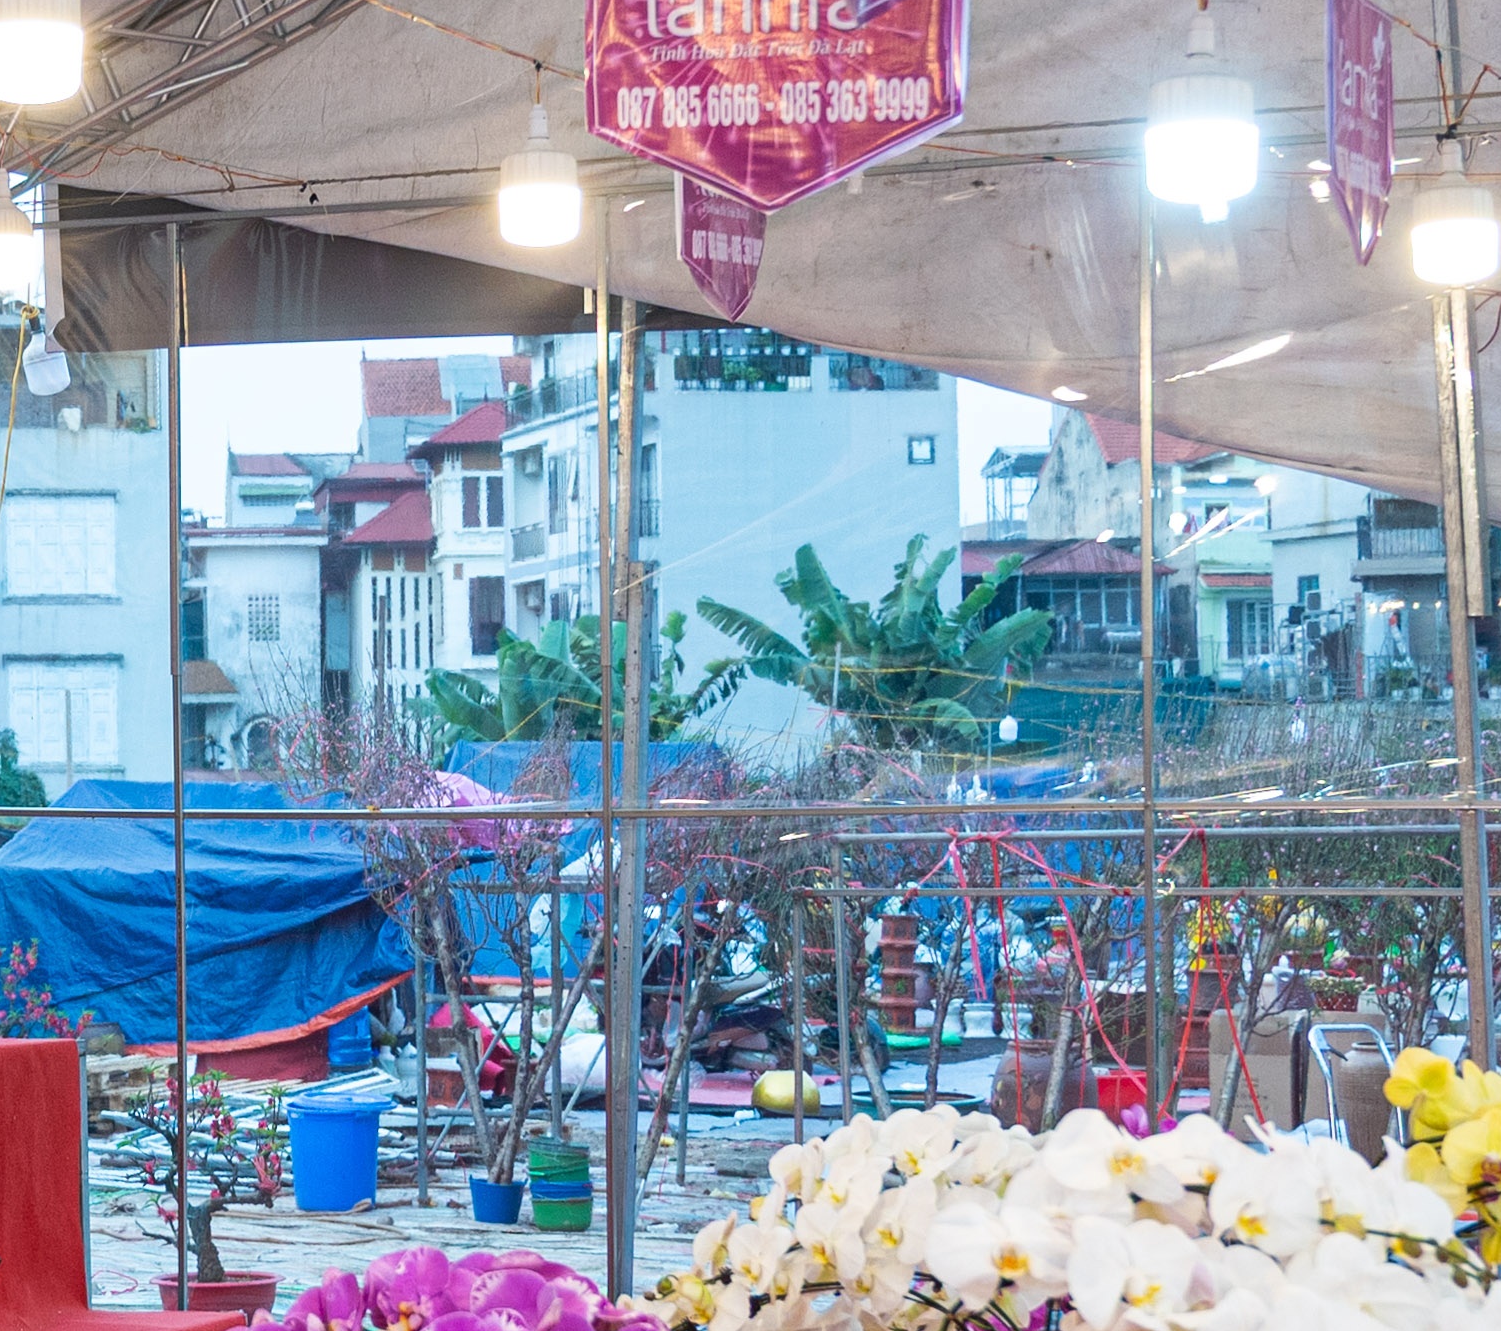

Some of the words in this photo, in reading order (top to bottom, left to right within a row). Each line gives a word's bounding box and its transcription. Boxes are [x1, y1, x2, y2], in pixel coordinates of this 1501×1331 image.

[616, 86, 657, 130] 087
[662, 85, 702, 129] 885
[706, 83, 760, 126] 6666
[780, 81, 822, 125] 085
[826, 79, 868, 123] 363
[873, 76, 930, 123] 9999
